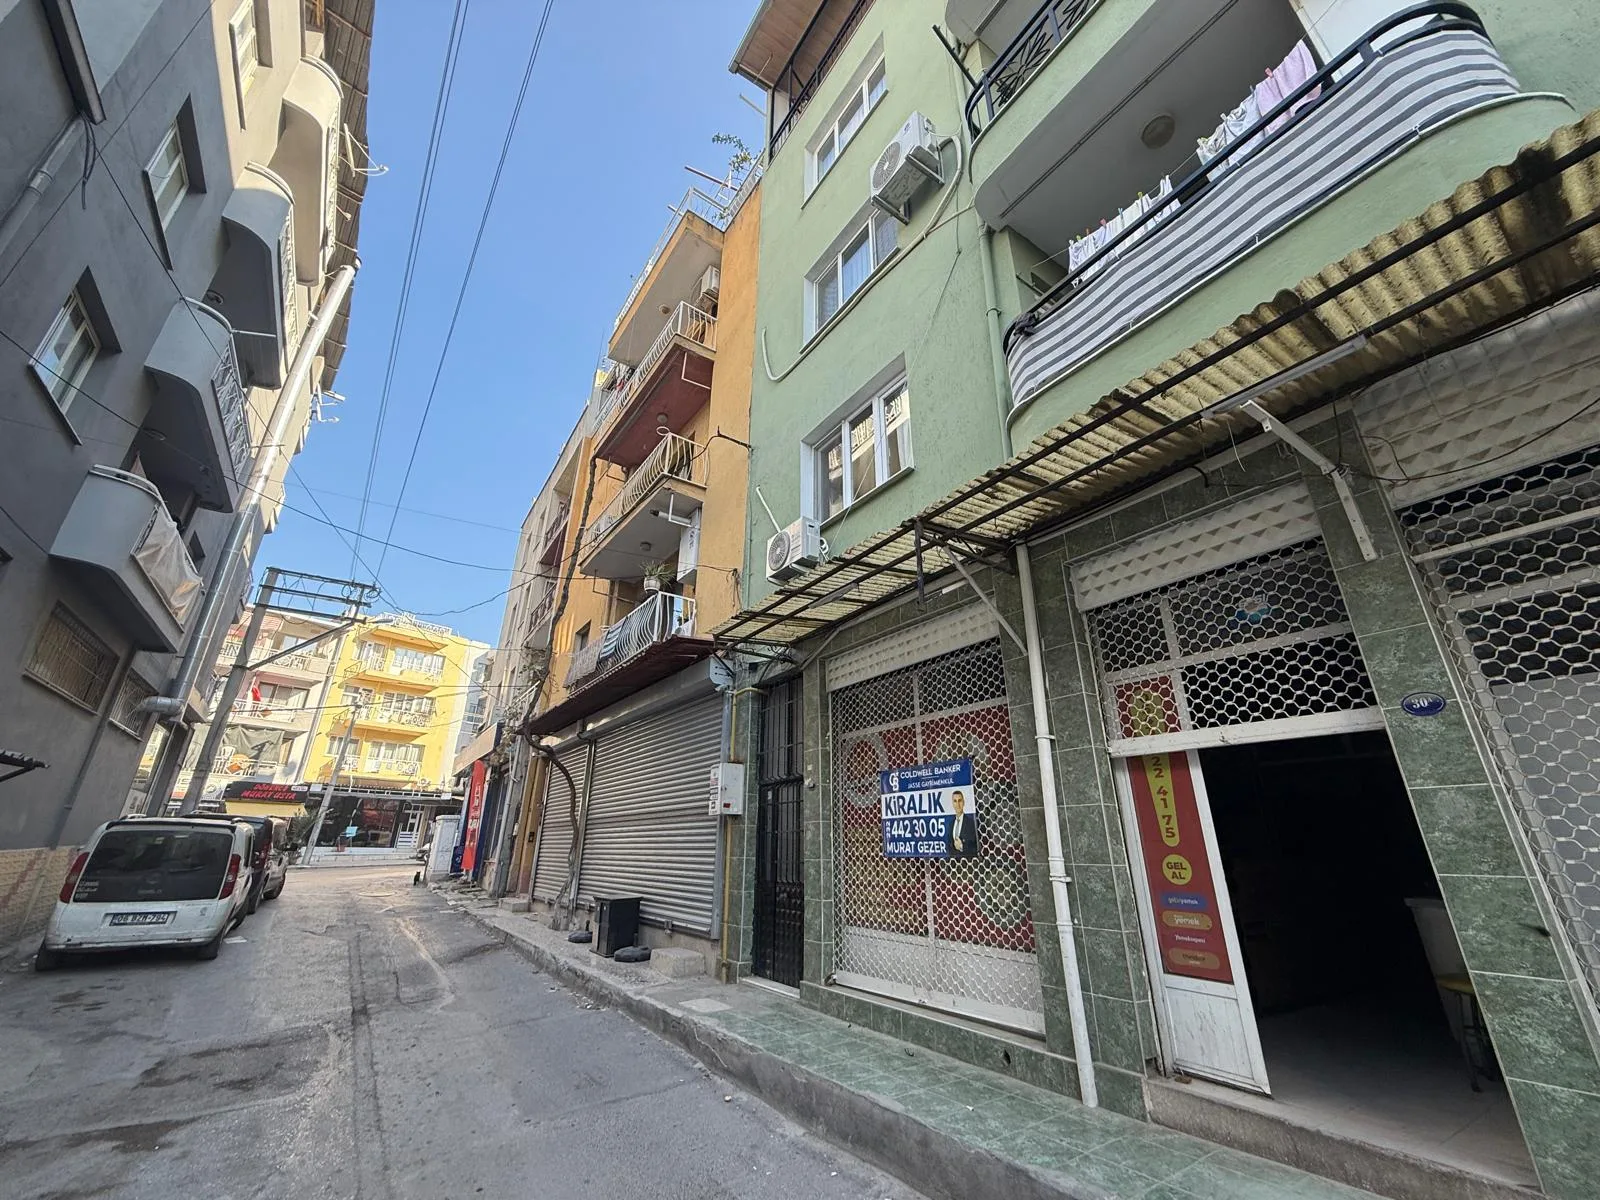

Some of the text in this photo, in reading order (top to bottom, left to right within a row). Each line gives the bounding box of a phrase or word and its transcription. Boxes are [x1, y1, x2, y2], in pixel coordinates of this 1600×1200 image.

[900, 764, 961, 779] COLDWELL BANKER
[891, 820, 912, 838] 442
[913, 818, 927, 838] 30
[929, 817, 946, 837] 05
[886, 841, 947, 854] MURAT GEZER
[1166, 861, 1187, 870] GEL
[1171, 870, 1186, 880] AL
